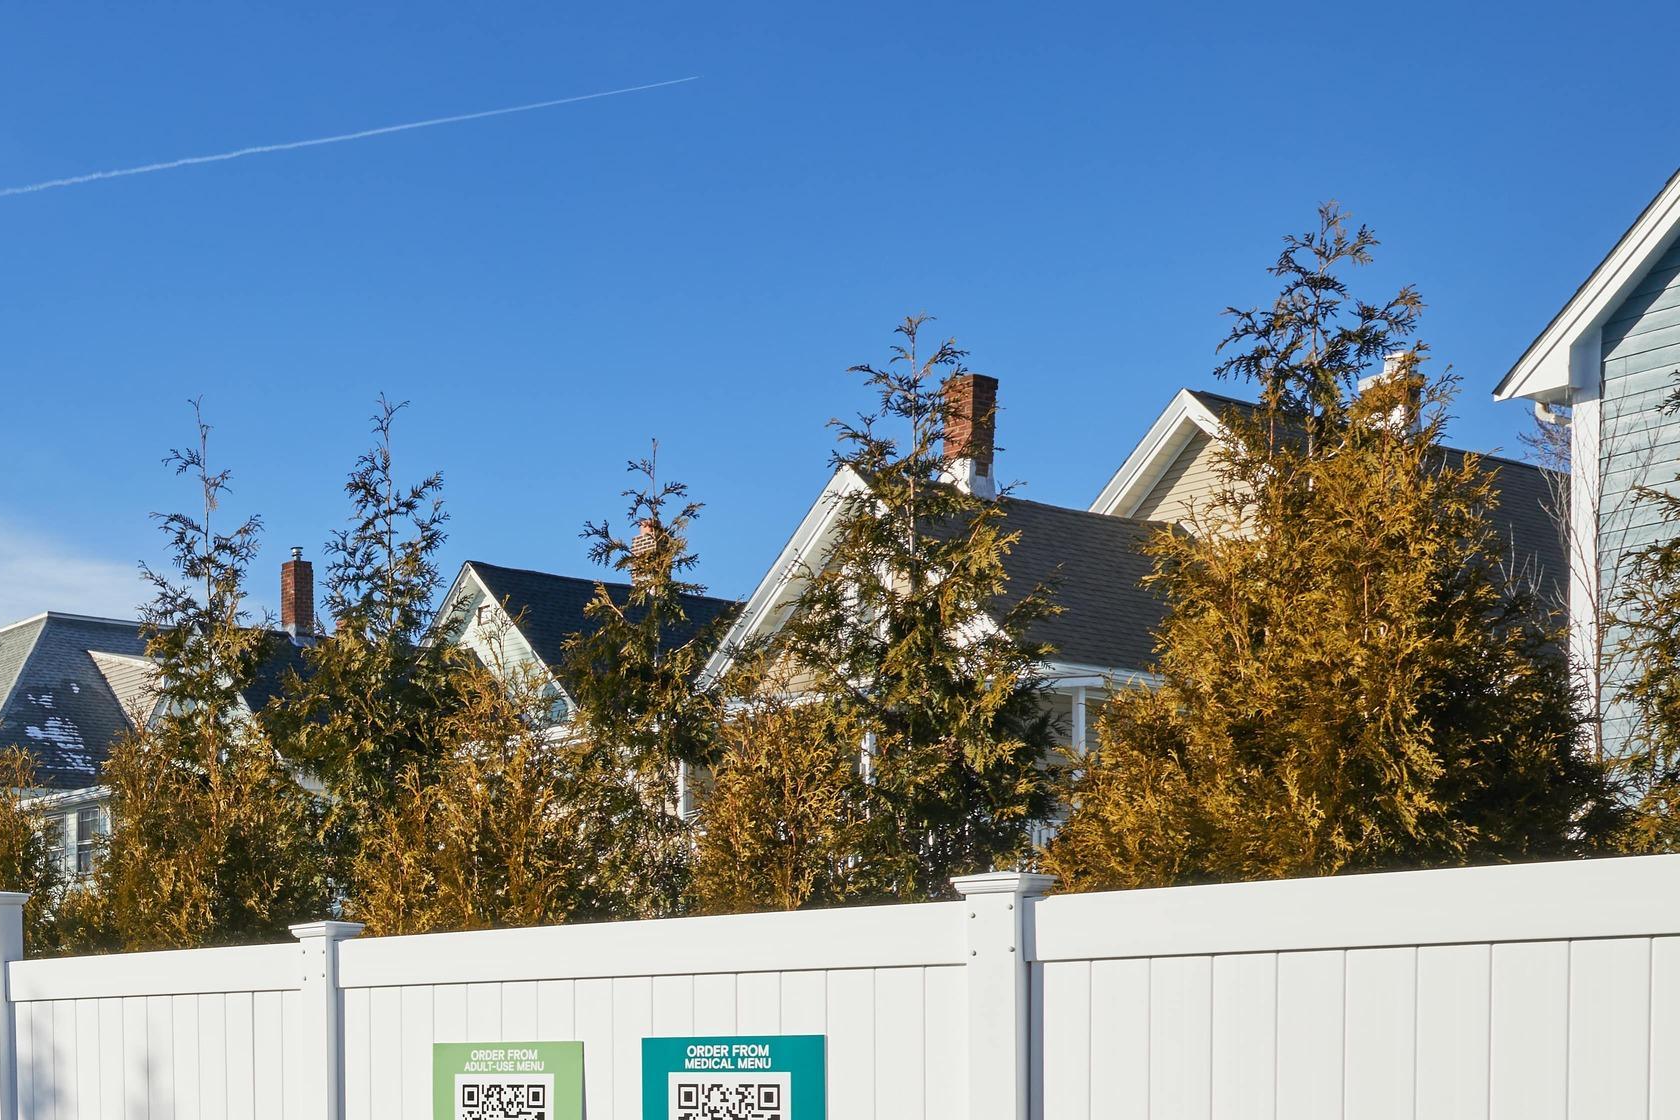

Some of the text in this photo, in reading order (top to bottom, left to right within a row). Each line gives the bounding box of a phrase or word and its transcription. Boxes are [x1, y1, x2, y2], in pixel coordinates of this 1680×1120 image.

[470, 1048, 538, 1061] ORDER FROM
[686, 1044, 769, 1057] ORDER FROM
[464, 1061, 545, 1072] ADULT-USE MENU
[684, 1058, 772, 1069] MEDICAL MENU
